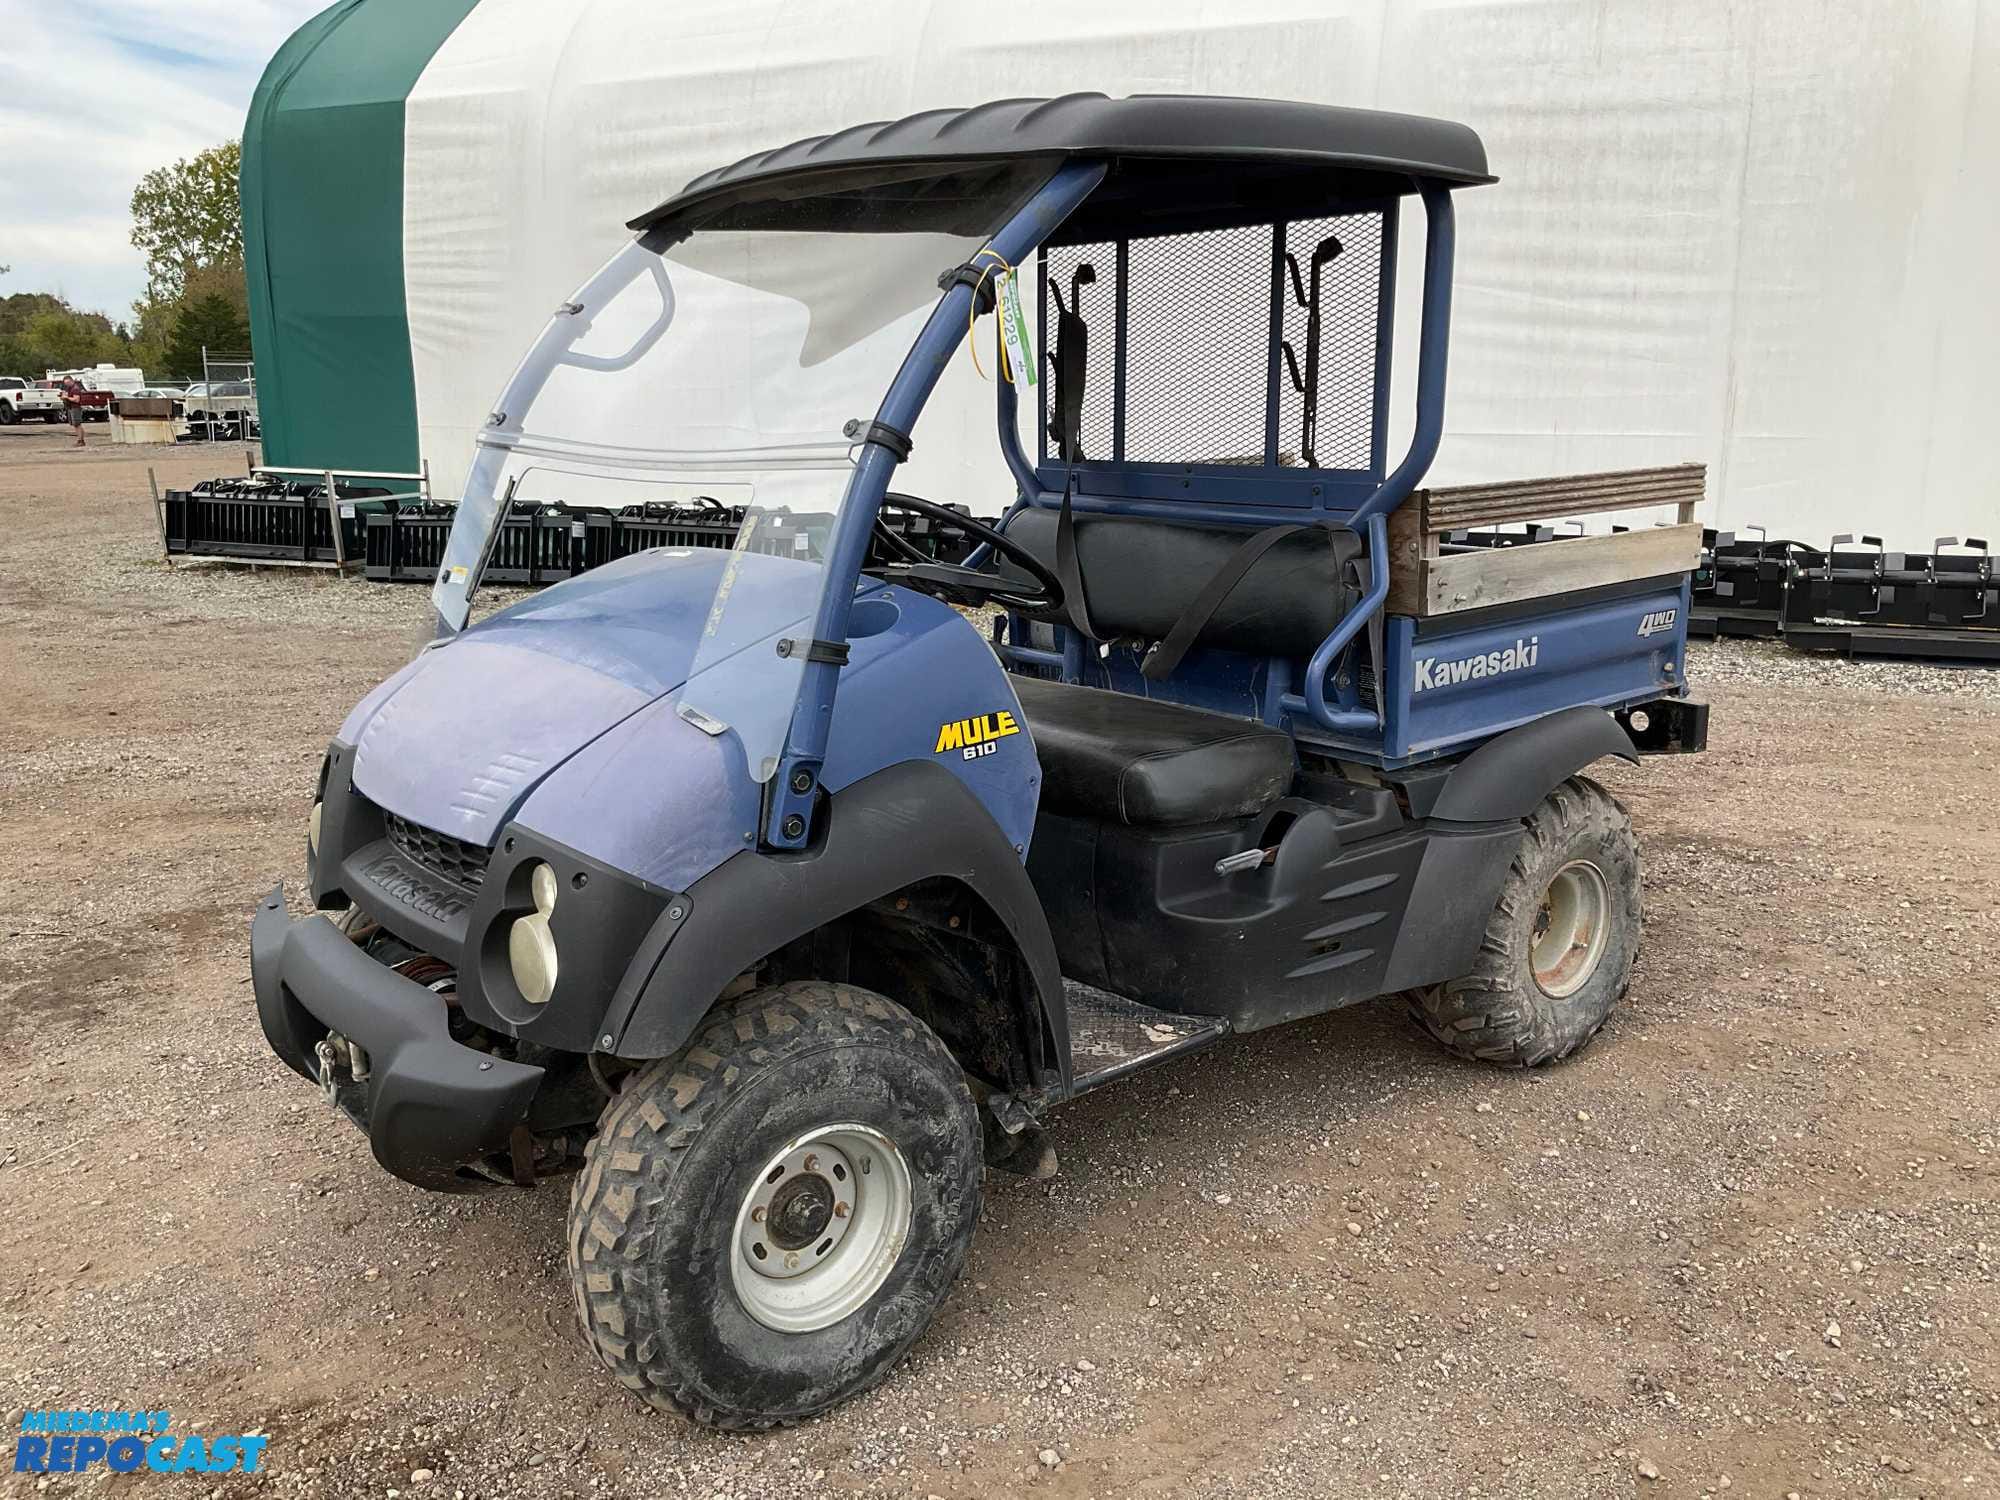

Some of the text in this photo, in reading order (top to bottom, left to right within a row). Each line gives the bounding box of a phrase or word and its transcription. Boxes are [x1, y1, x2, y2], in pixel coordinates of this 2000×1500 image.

[1637, 609, 1676, 638] 4WD
[1414, 636, 1538, 693] Kawasaki
[934, 710, 1020, 753] MULE
[963, 741, 998, 761] 610
